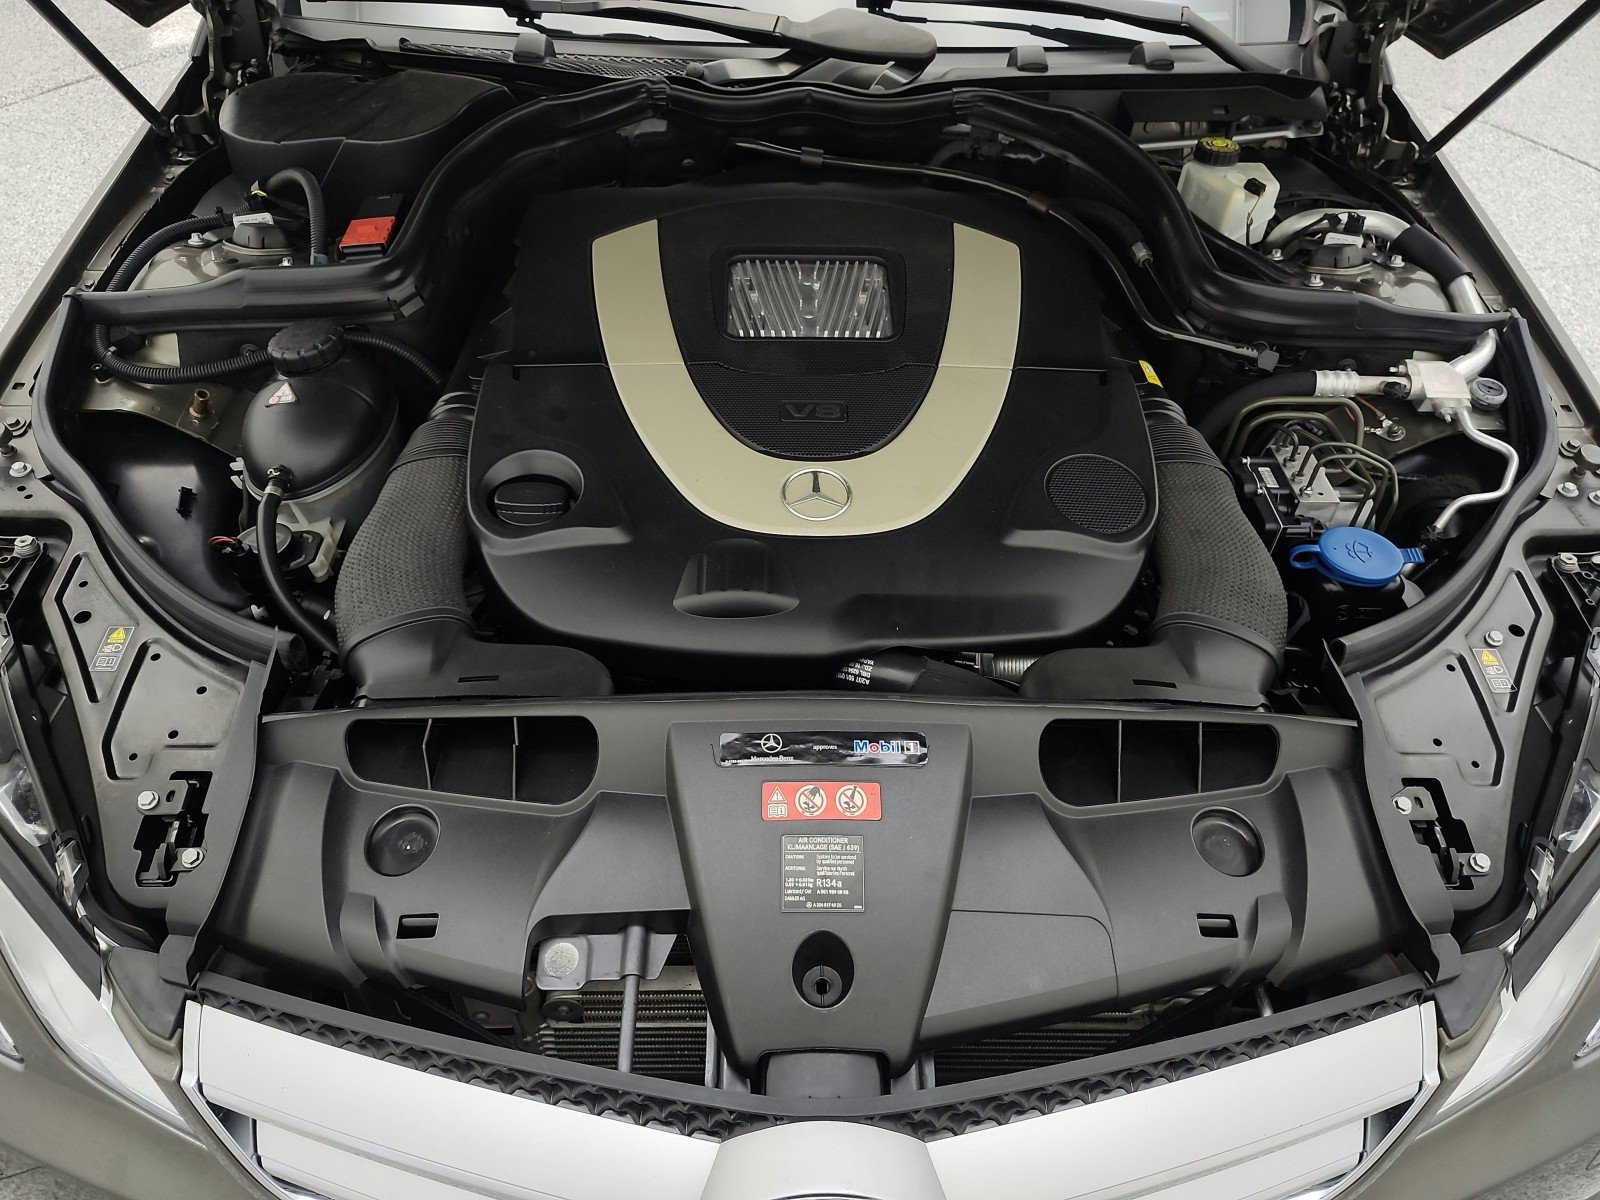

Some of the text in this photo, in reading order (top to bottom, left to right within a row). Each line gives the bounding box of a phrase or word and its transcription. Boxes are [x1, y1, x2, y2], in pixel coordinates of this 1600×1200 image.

[785, 404, 841, 418] V8
[853, 740, 902, 754] Mobil
[750, 755, 794, 763] Mercedes-Benz
[787, 843, 828, 851] KLIMAANLAGE
[828, 844, 843, 852] (SAE
[846, 844, 860, 852] 639)
[816, 878, 842, 888] R134a
